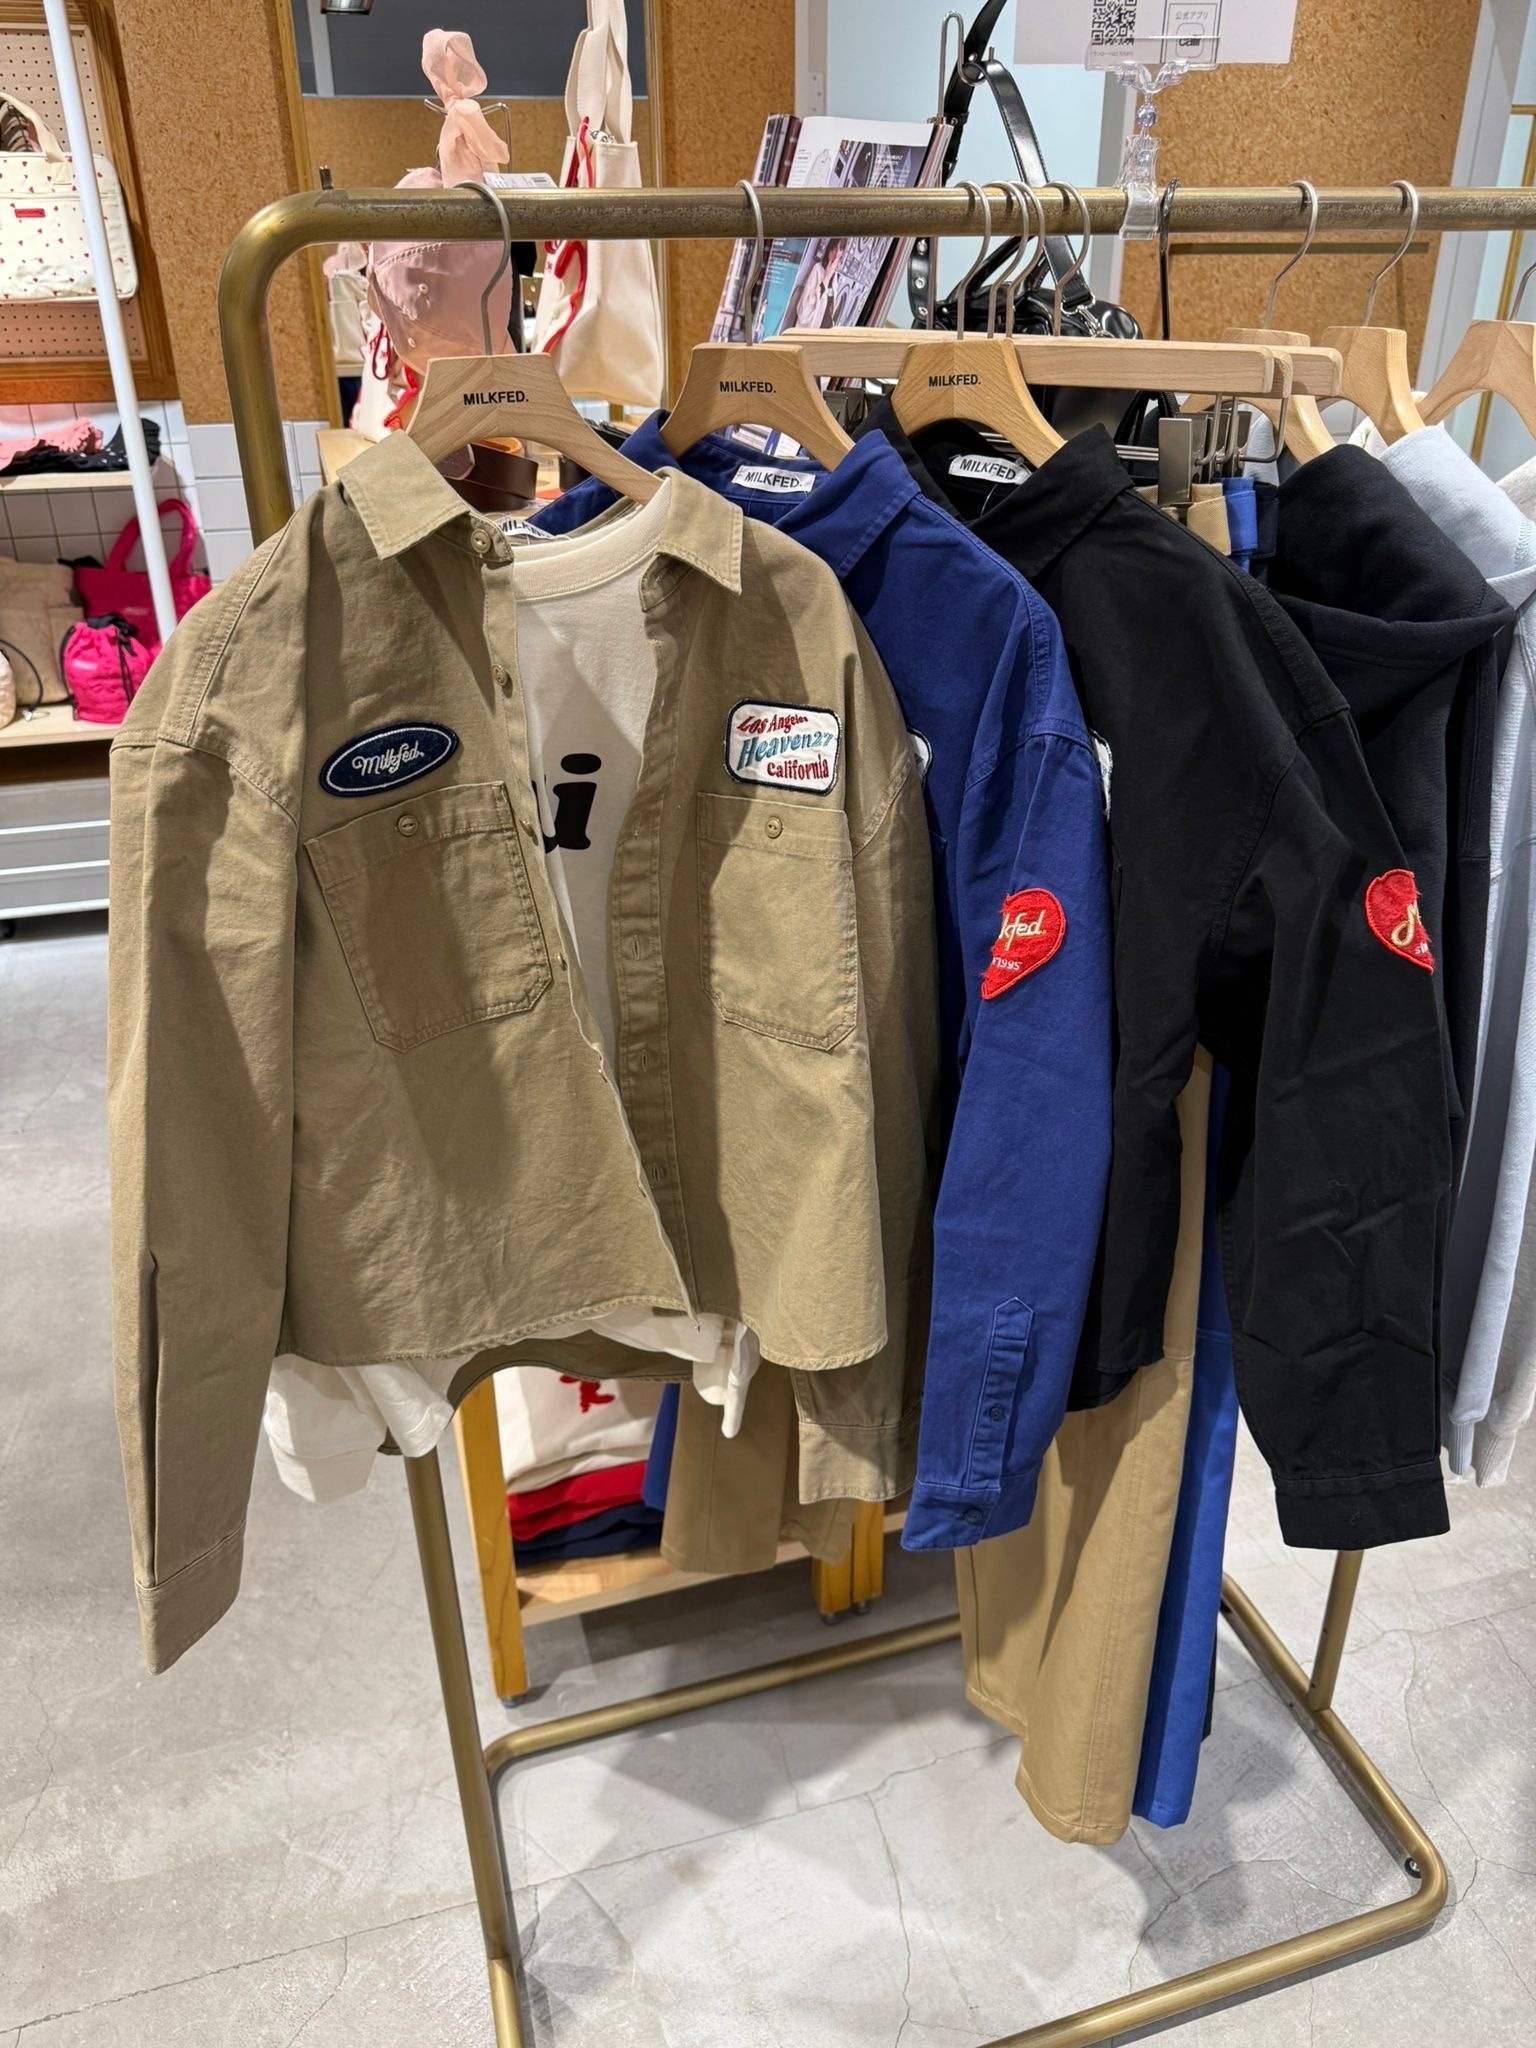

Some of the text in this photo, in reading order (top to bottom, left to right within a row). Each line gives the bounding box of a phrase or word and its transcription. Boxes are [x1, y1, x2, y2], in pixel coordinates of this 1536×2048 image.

[719, 380, 776, 393] MILKFED.
[928, 374, 981, 387] MILKFED.
[463, 390, 529, 406] MILKFED.
[744, 471, 802, 488] MILKFED.
[737, 713, 808, 734] Los Angeles
[352, 740, 425, 777] Milkfed.
[736, 731, 834, 772] Heaven27
[766, 753, 830, 781] California
